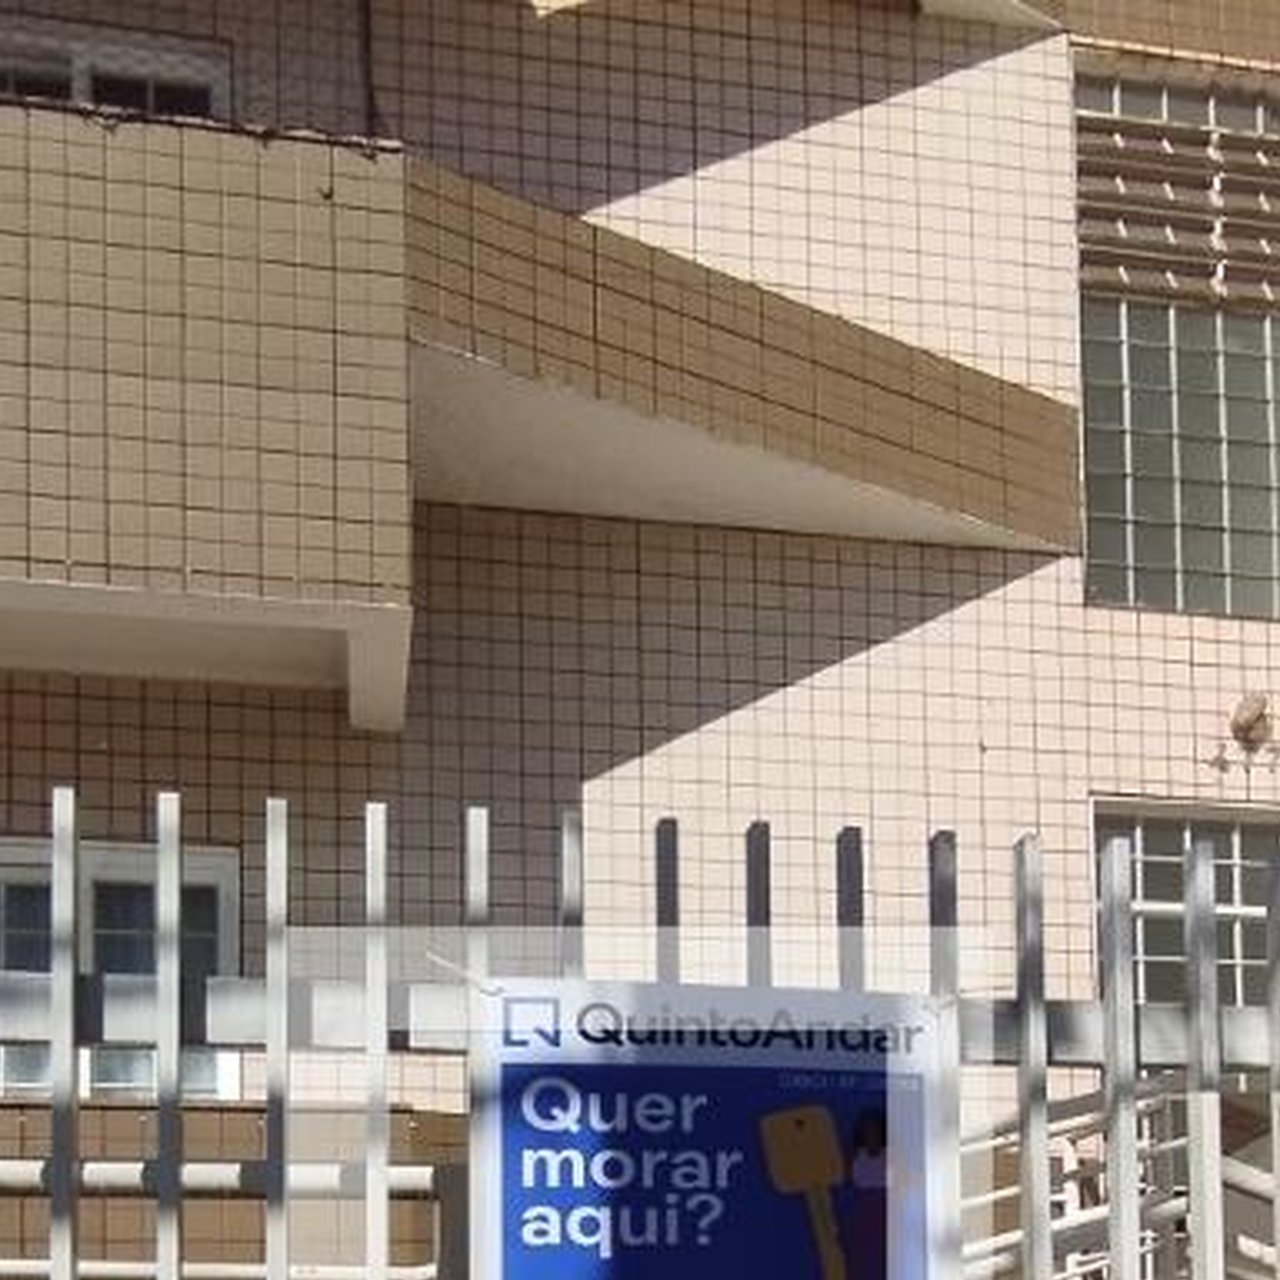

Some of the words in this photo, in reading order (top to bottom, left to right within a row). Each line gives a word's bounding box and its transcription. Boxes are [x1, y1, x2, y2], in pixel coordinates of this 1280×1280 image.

[577, 1003, 921, 1054] QuintoAndar
[521, 1076, 706, 1132] Quer
[521, 1147, 742, 1189] morar
[521, 1195, 723, 1259] aqui?
